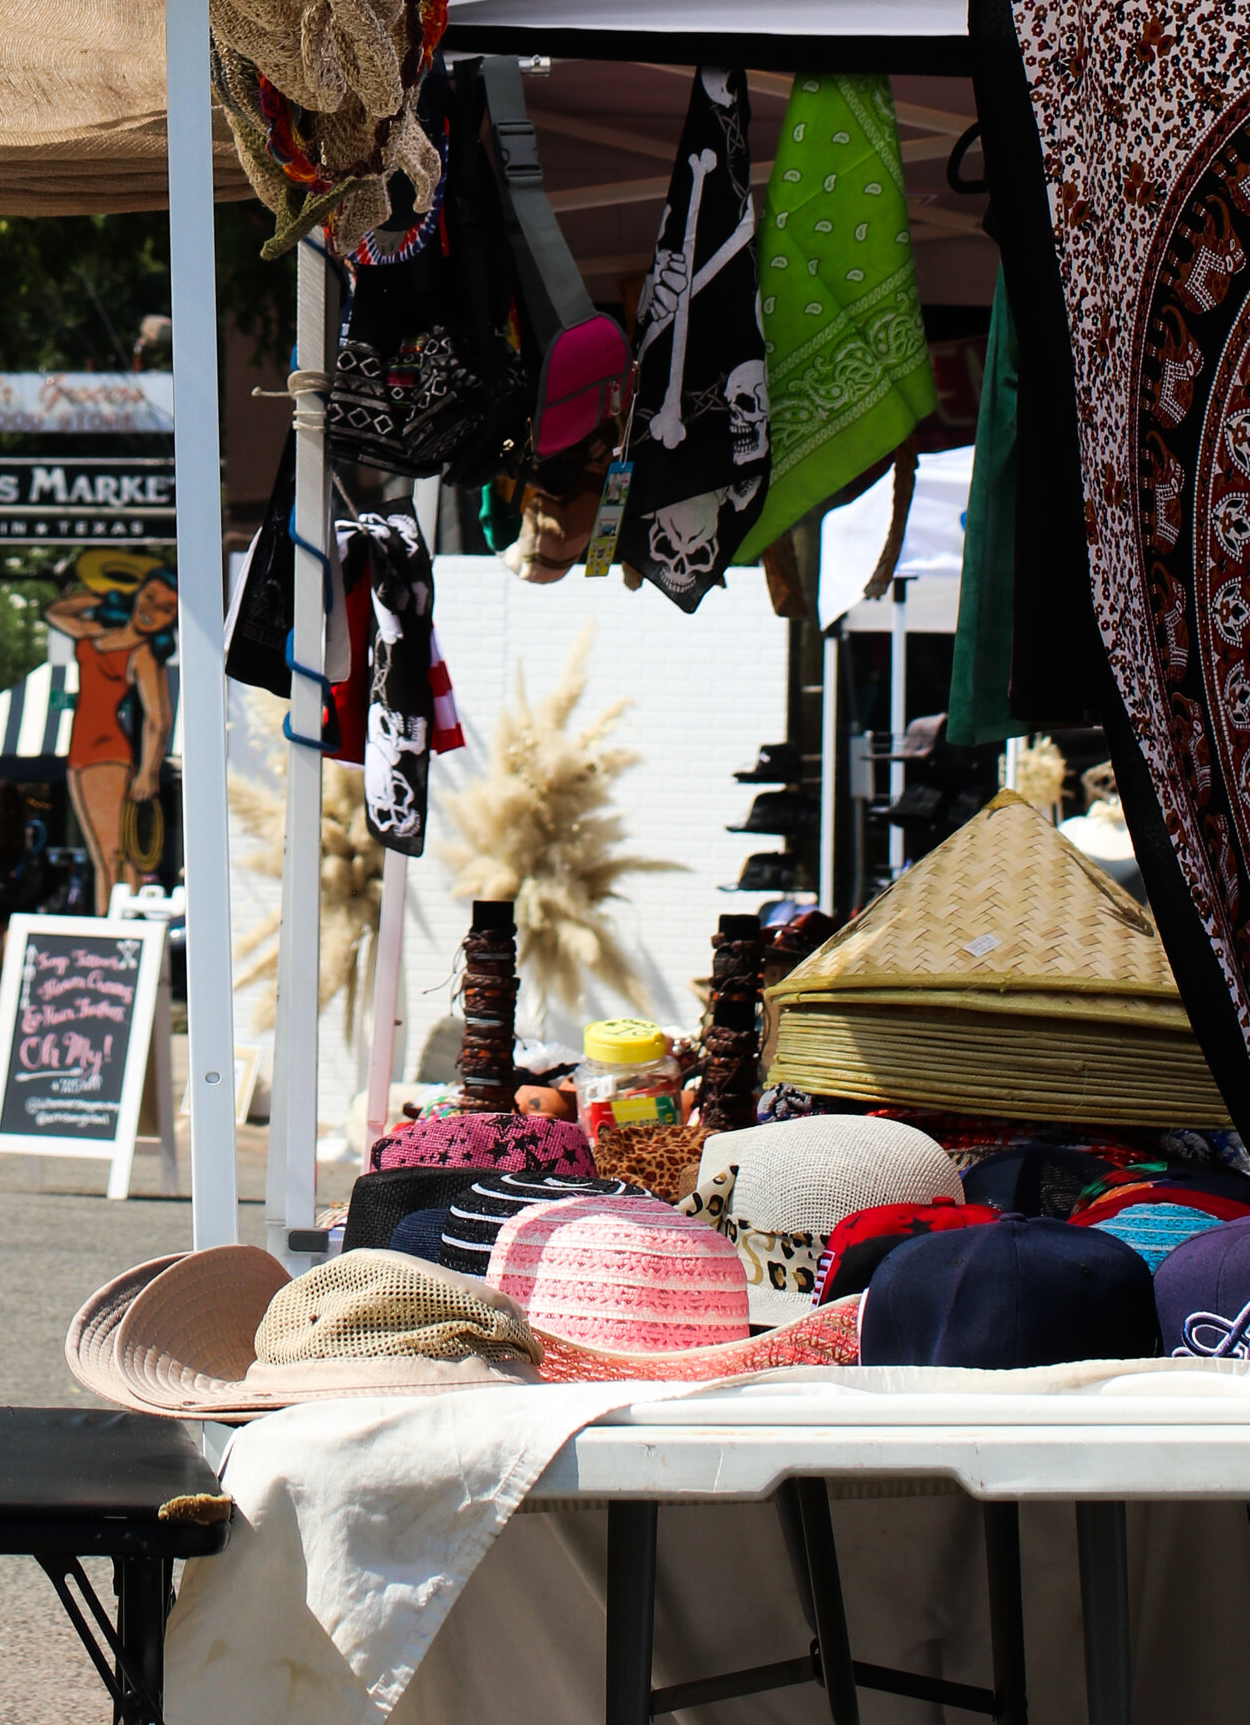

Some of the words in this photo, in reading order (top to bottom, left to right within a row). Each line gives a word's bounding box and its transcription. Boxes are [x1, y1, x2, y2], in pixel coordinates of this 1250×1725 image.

[29, 467, 175, 507] MARKE
[57, 521, 145, 536] TEXAS
[19, 1032, 61, 1069] Oh
[62, 1031, 113, 1080] My!
